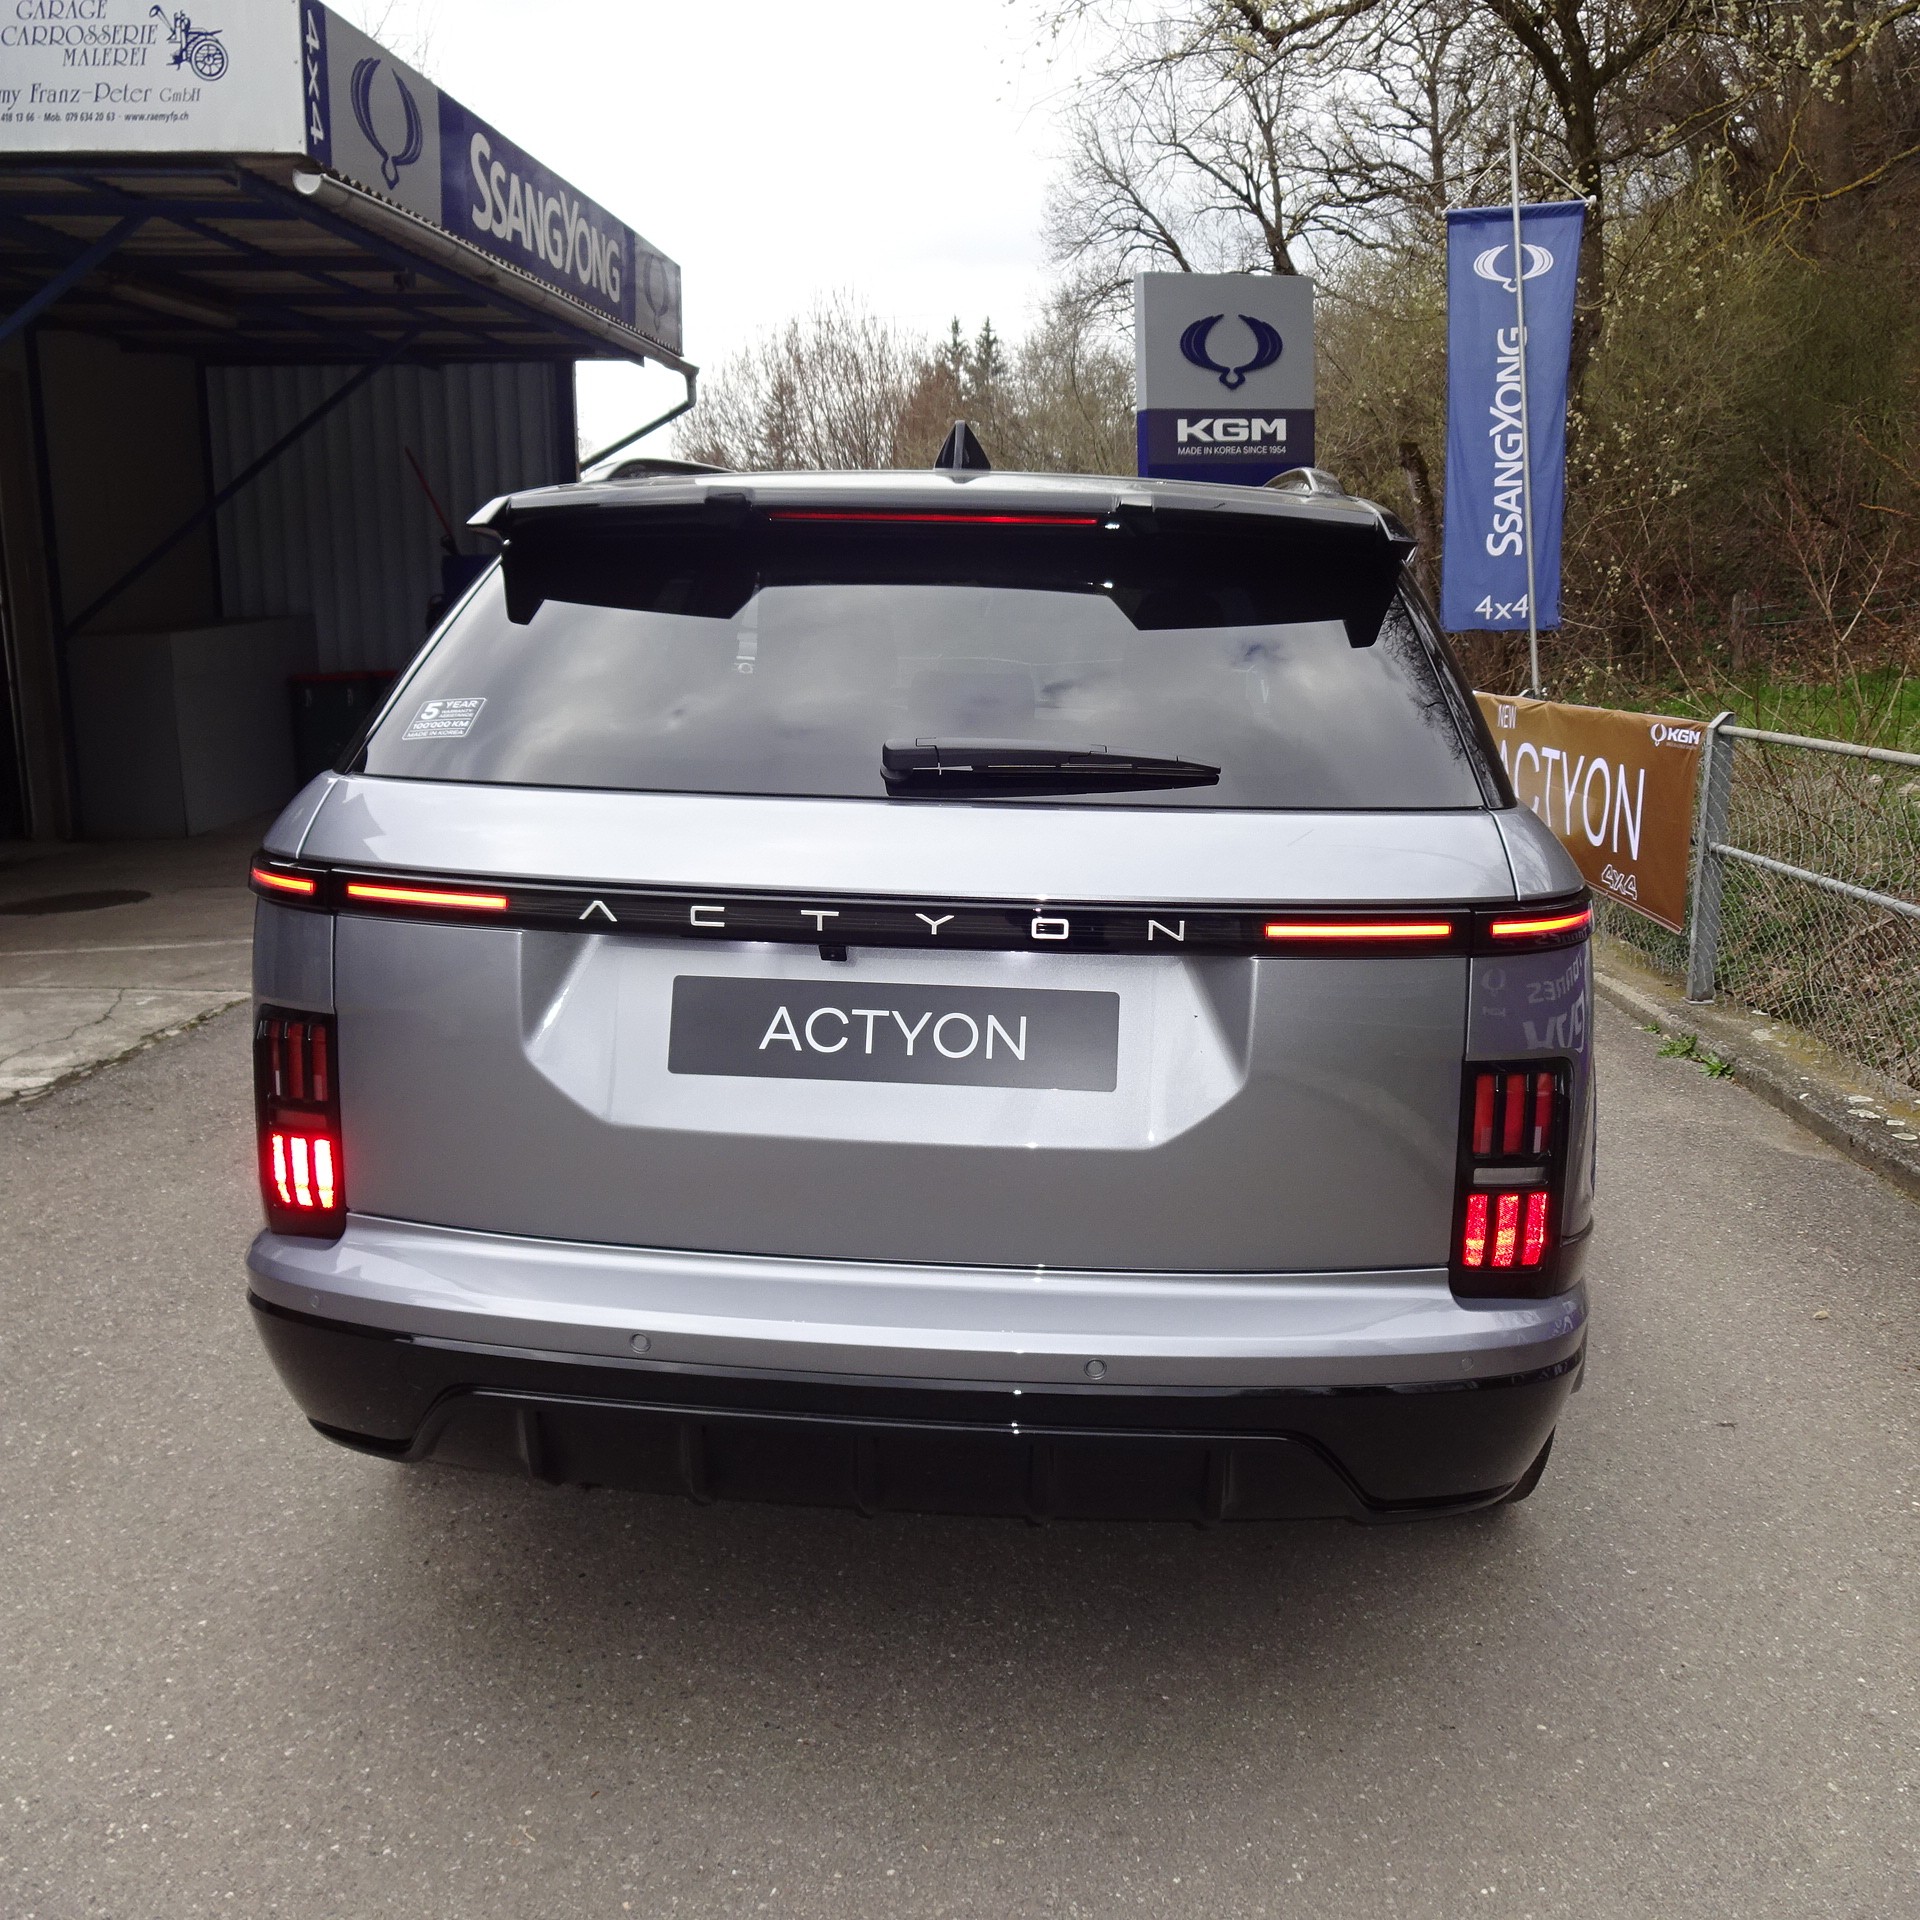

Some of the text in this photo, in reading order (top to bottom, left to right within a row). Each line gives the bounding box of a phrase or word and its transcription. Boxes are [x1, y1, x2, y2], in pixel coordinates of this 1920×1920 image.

[16, 0, 108, 20] GARAGE
[1, 24, 158, 46] CARROSSERIE
[62, 47, 148, 67] MALEREI
[30, 82, 153, 104] Franz-Peter
[159, 87, 201, 102] GmbH
[16, 112, 23, 122] 13
[26, 112, 35, 122] 66
[43, 112, 61, 122] Mob.
[65, 112, 78, 122] 079
[80, 112, 93, 122] 634
[95, 112, 104, 122] 20
[106, 112, 116, 122] 63
[470, 132, 621, 303] SSANGYONG
[1177, 418, 1287, 442] KGM
[1178, 445, 1287, 455] MADE IN KOREA SINCE 1954
[1486, 326, 1528, 557] SSANGYONG
[421, 702, 443, 720] 5
[1497, 704, 1518, 729] NEW
[578, 900, 1187, 944] ACTYON
[758, 1006, 1028, 1061] ACTYON
